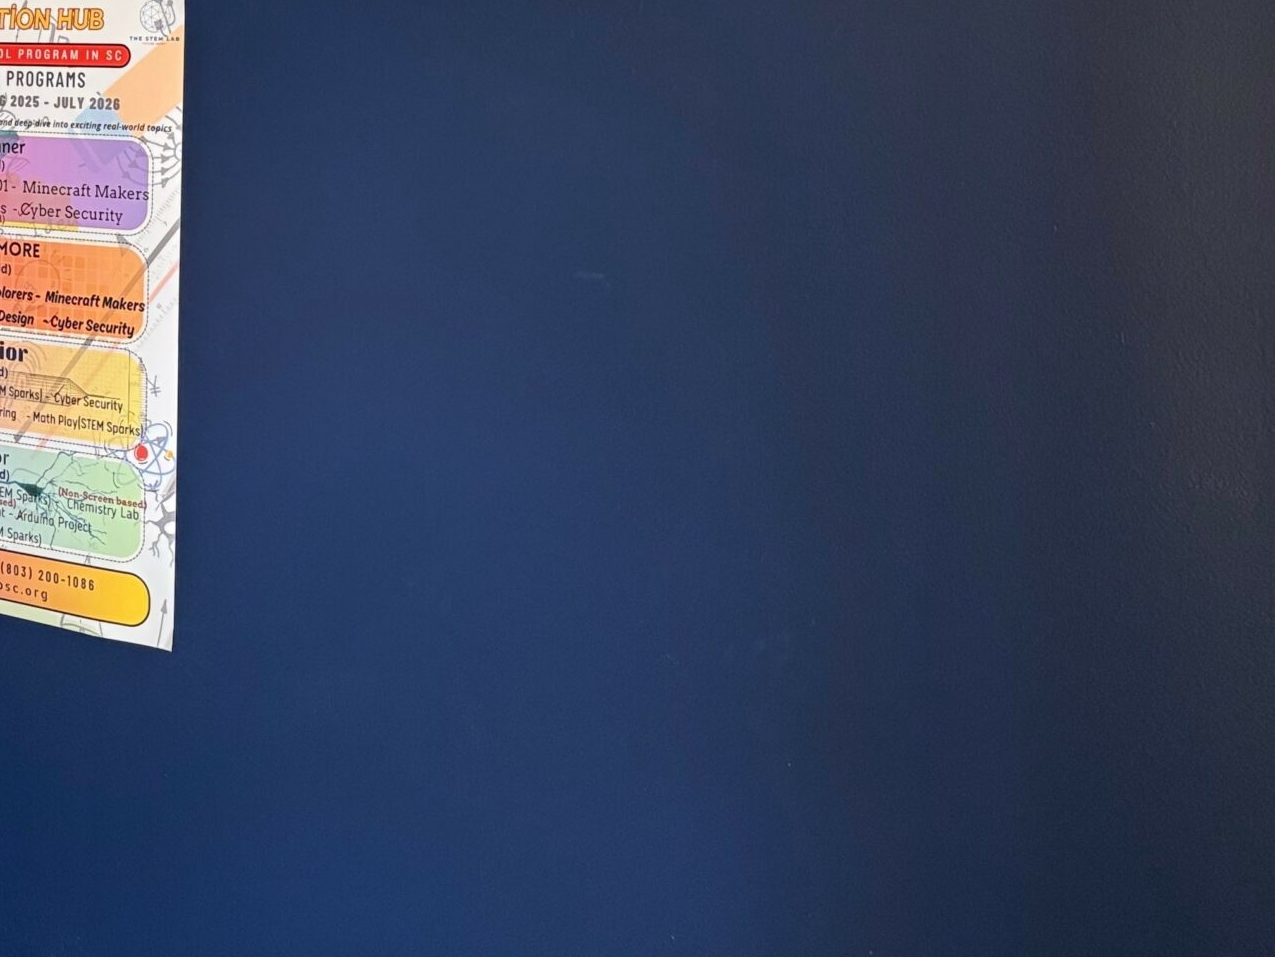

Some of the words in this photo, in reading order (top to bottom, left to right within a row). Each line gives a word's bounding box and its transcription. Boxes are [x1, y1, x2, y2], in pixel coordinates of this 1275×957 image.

[57, 8, 105, 31] HUB
[18, 49, 79, 60] PROGRAM
[86, 50, 99, 60] IN
[107, 50, 123, 61] SC
[7, 71, 86, 88] PROGRAMS
[11, 96, 40, 108] 2025
[54, 96, 84, 109] JULY
[89, 98, 120, 110] 2026
[0, 118, 13, 126] and
[53, 120, 68, 128] into
[71, 121, 101, 131] exciting
[103, 122, 144, 131] real-world
[147, 124, 172, 133] topics
[23, 180, 91, 197] Minecraft
[95, 185, 149, 201] Makers
[20, 202, 61, 221] Cyber
[65, 206, 123, 225] Security
[45, 291, 100, 307] Minecraft
[103, 296, 145, 312] Makers
[51, 315, 83, 331] Cyber
[86, 320, 134, 339] Security
[1, 562, 33, 580] (803)
[39, 570, 95, 591] 200-1086
